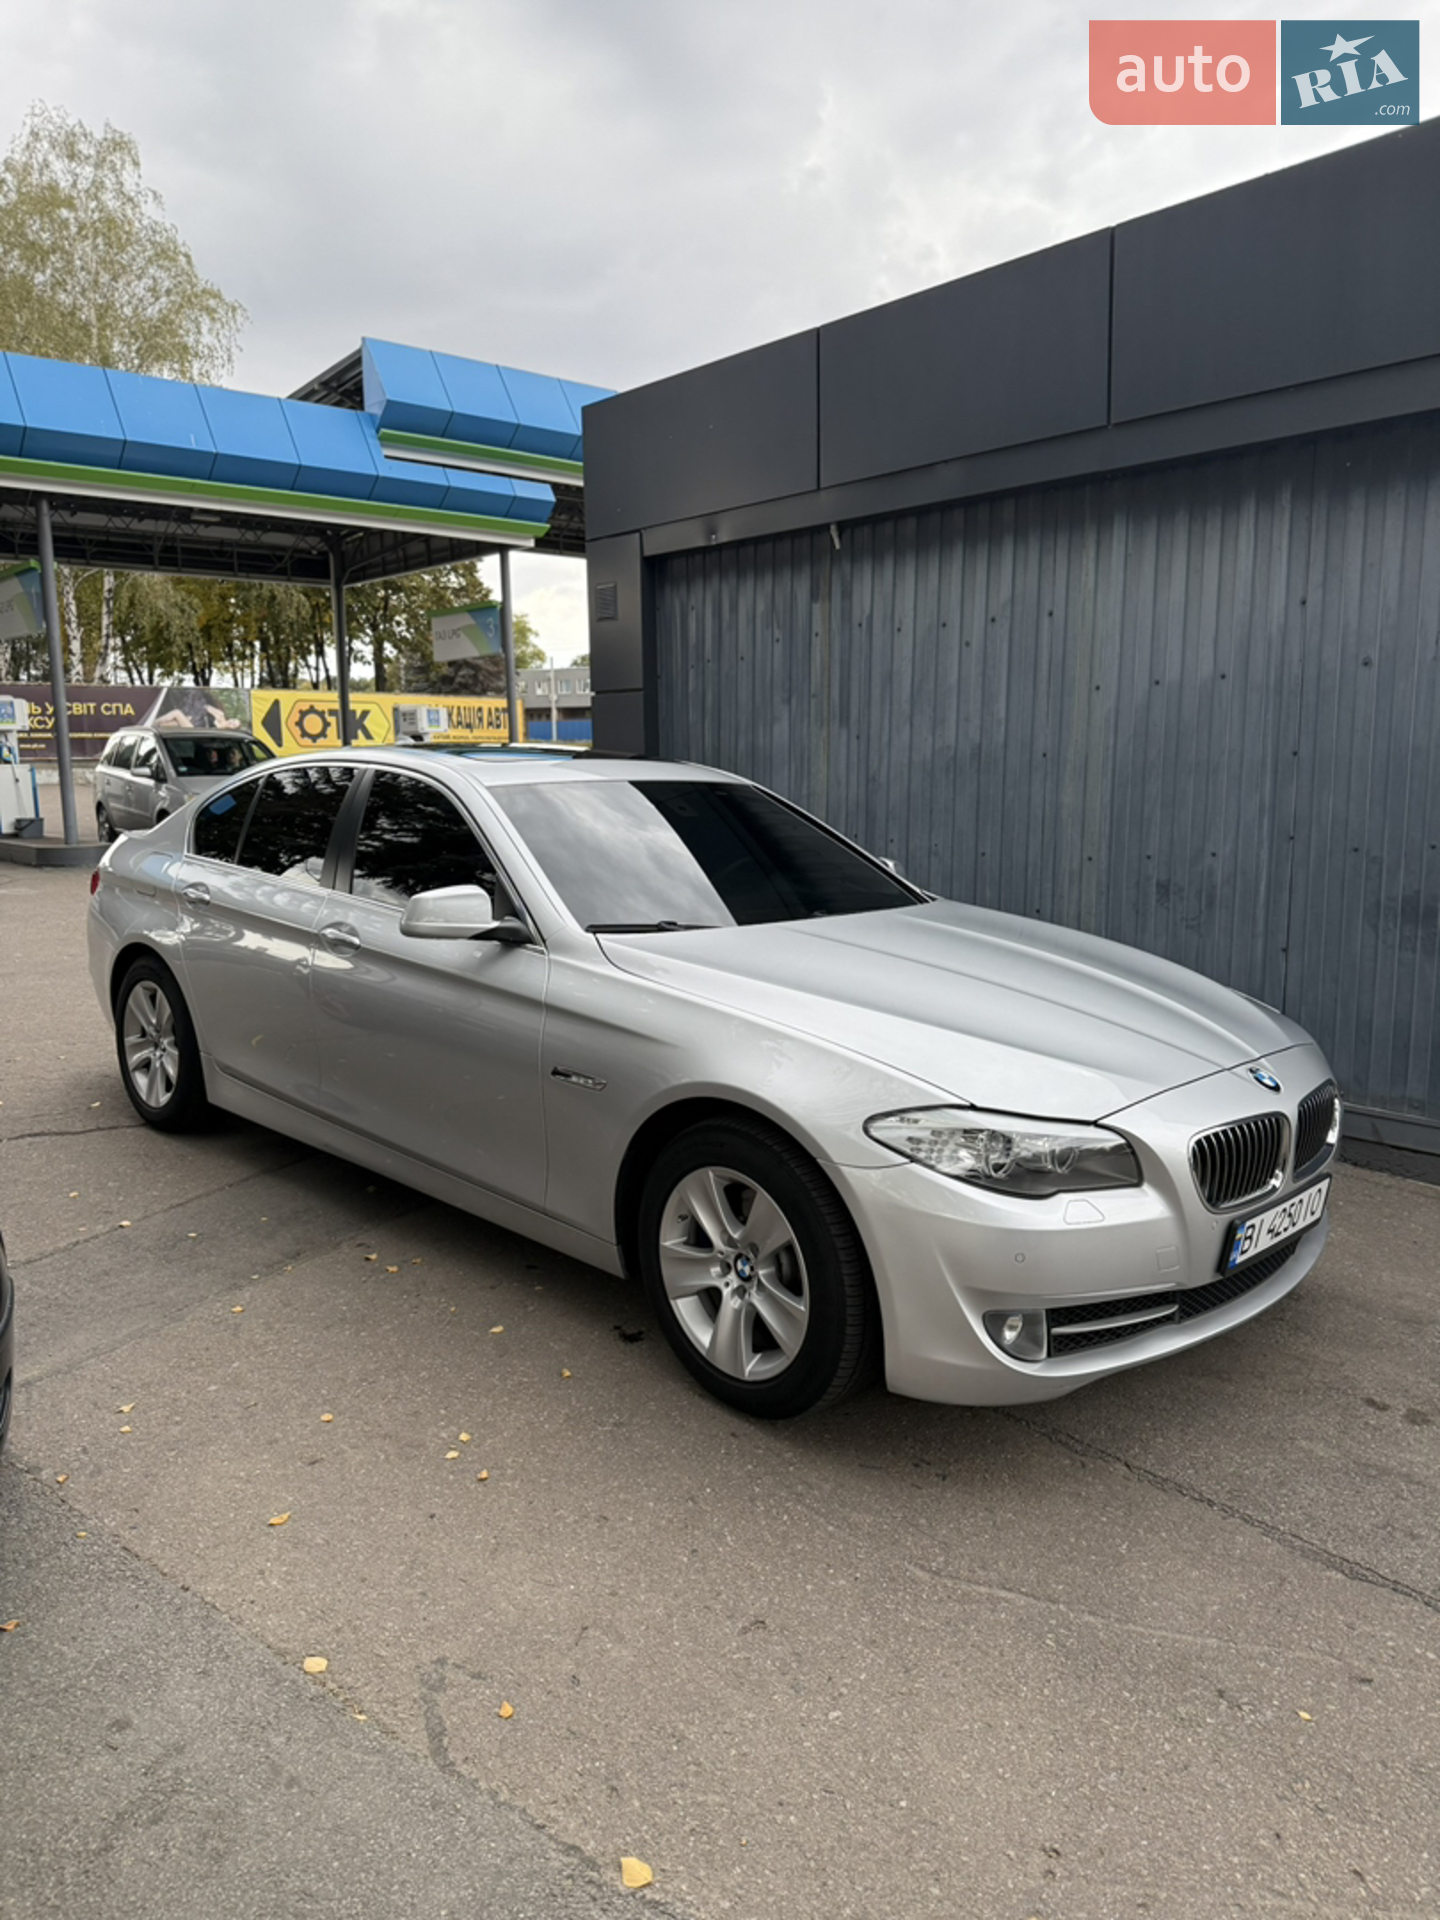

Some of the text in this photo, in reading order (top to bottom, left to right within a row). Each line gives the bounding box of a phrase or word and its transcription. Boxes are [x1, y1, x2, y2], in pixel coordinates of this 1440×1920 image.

[487, 617, 495, 638] 3
[101, 703, 136, 716] СПА
[1240, 1218, 1264, 1257] BI
